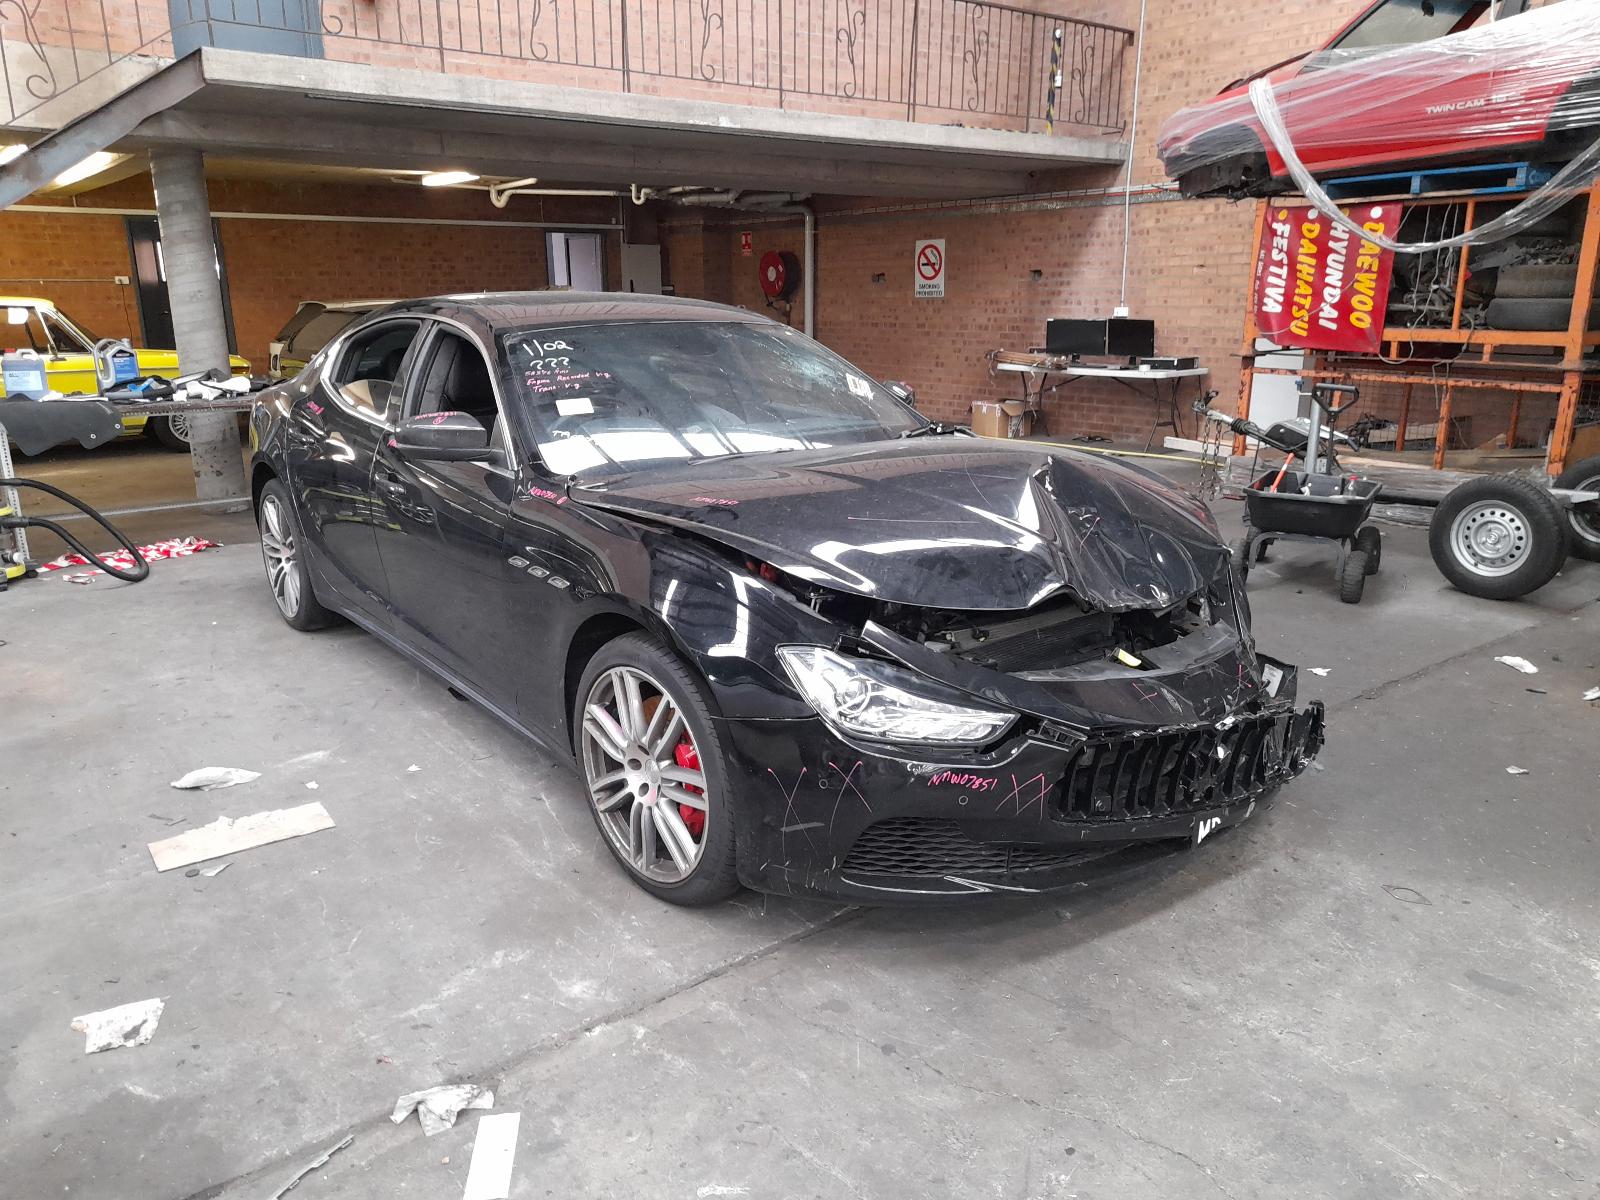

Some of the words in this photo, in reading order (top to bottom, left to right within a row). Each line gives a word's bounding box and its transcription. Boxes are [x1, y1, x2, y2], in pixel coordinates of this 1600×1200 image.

[1426, 103, 1456, 114] TWIN
[1456, 98, 1486, 110] CAM
[1262, 222, 1291, 313] FESTIVA
[1290, 222, 1321, 337] DAIHATSU
[1318, 221, 1350, 330] HYUNDAI
[1350, 222, 1385, 329] DAEWOO
[927, 770, 998, 792] NMW07851
